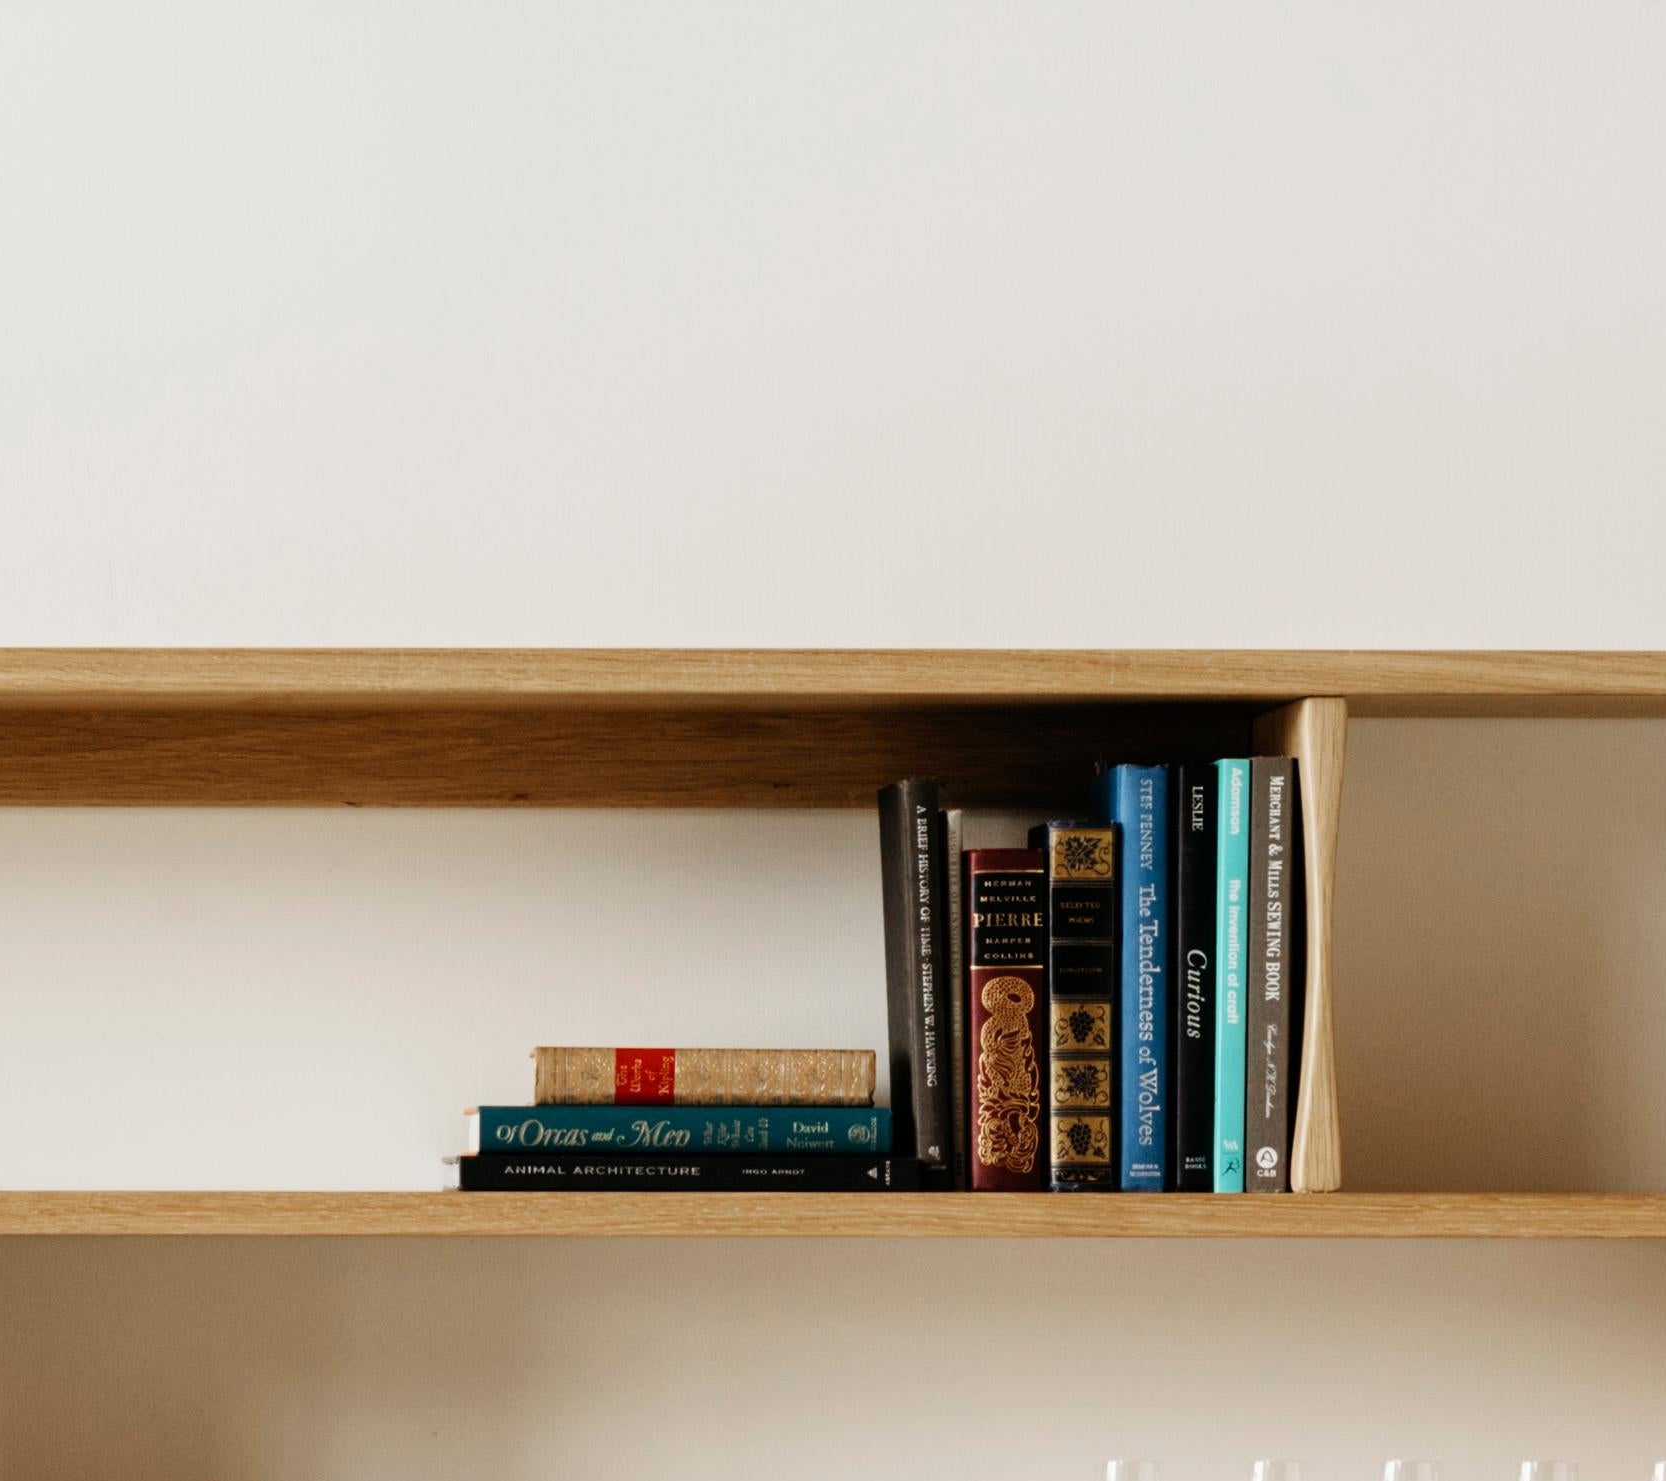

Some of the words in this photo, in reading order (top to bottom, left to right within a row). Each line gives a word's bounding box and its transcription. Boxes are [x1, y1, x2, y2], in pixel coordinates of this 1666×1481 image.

[916, 805, 927, 814] A
[1140, 779, 1153, 810] STEF
[1192, 786, 1204, 832] LESLIE
[1230, 767, 1243, 835] Adamson
[1269, 775, 1285, 841] MERCHANT
[916, 817, 929, 855] BRIEF
[1140, 814, 1153, 870] PENNEY
[1268, 843, 1284, 857] &
[918, 854, 931, 904] HISTORY
[1229, 879, 1241, 902] the
[1267, 859, 1283, 899] MILLS
[920, 906, 931, 921] OF
[1139, 883, 1156, 918] The
[973, 912, 1044, 928] PIERRE
[1227, 906, 1242, 970] invention
[1266, 901, 1282, 958] SEWING
[920, 926, 932, 956] TIME
[922, 963, 935, 1013] STEPHEN
[1139, 919, 1161, 1041] Tenderness
[1187, 949, 1208, 1039] Curious
[1227, 974, 1239, 988] of
[1265, 962, 1281, 1002] BOOK
[1227, 990, 1239, 1025] craft
[925, 1031, 938, 1087] HAWKING
[1139, 1046, 1157, 1065] of
[1139, 1066, 1161, 1146] Wolves
[496, 1124, 519, 1144] Of
[519, 1119, 589, 1146] Orcas
[591, 1127, 615, 1141] and
[616, 1119, 691, 1147] Men
[786, 1136, 834, 1149] Neiwert
[792, 1121, 829, 1134] David
[504, 1165, 566, 1175] ANIMAL
[572, 1166, 701, 1176] ARCHITECTURE
